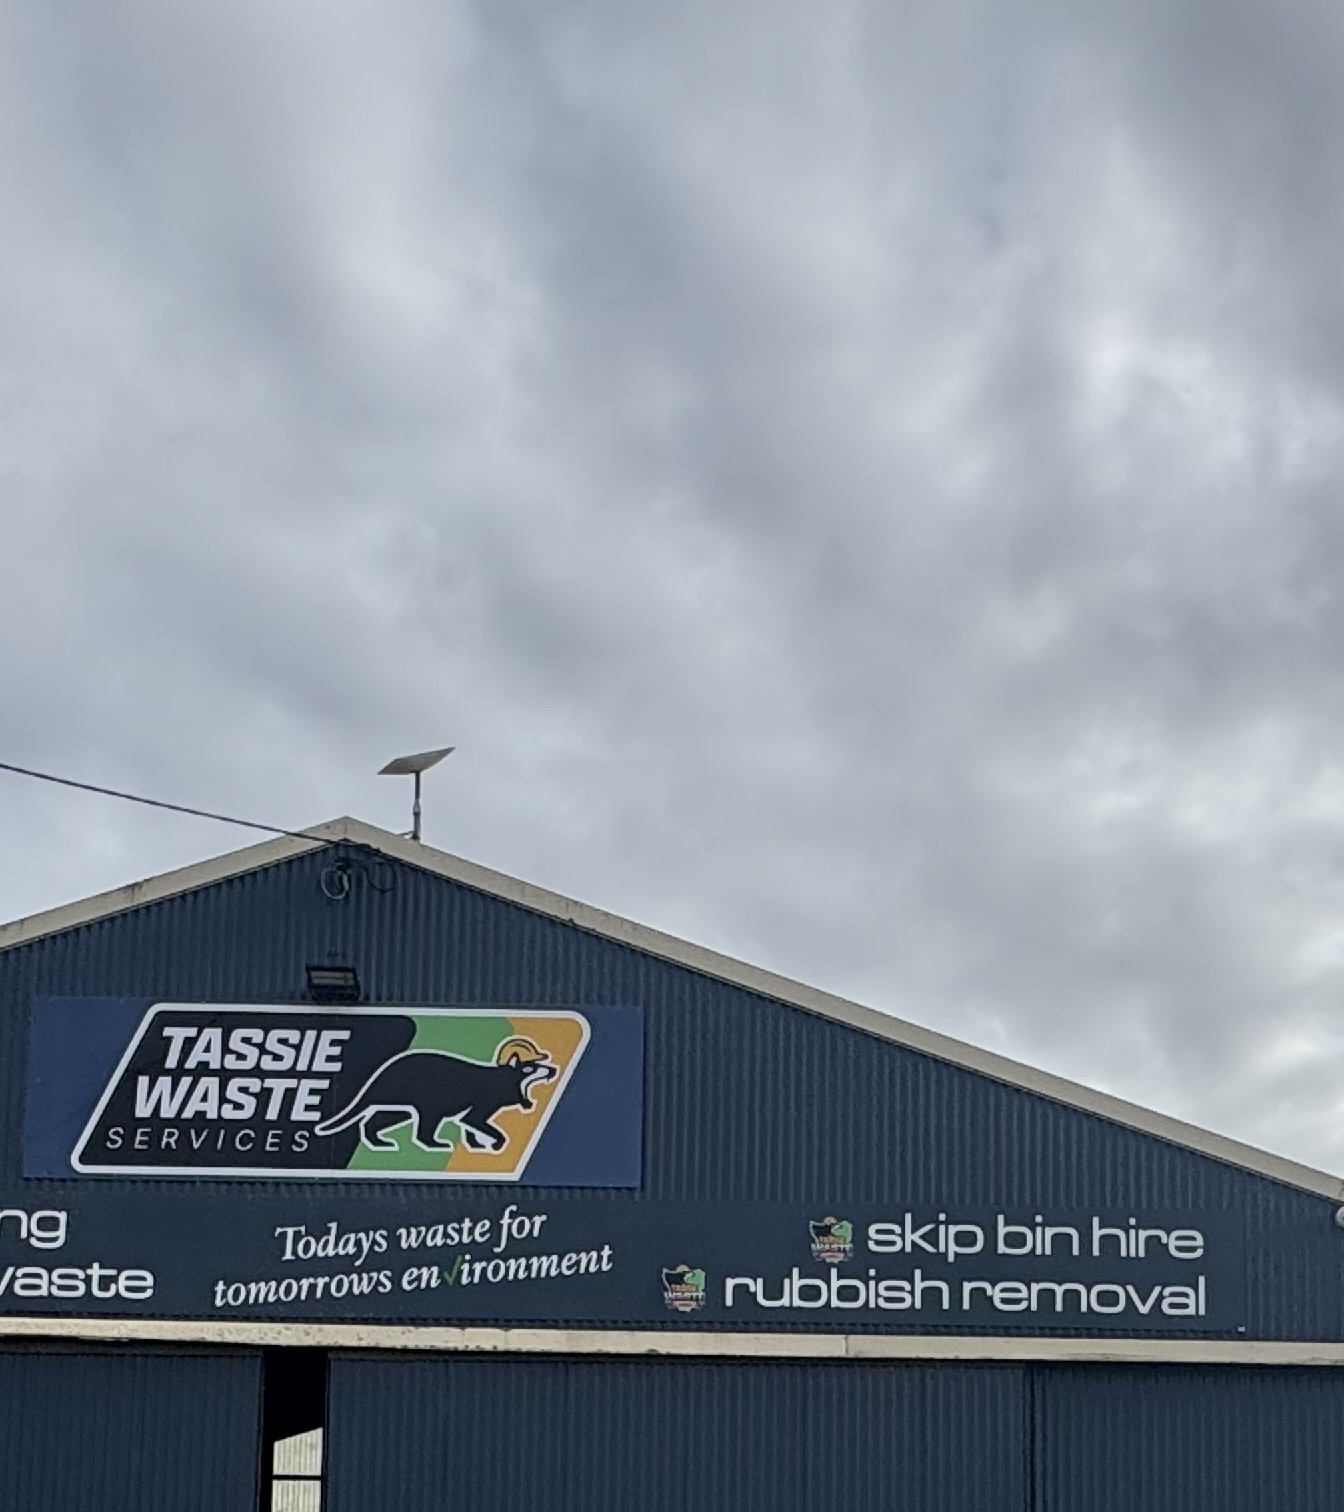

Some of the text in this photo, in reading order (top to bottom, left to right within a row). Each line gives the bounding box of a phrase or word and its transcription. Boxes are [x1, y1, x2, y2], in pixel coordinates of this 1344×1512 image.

[163, 1027, 350, 1071] TASSIE
[135, 1076, 323, 1121] WASTE
[107, 1128, 309, 1151] SERVICES
[275, 1205, 547, 1264] Todays waste for
[868, 1213, 983, 1262] skip
[998, 1215, 1079, 1255] bin
[1093, 1217, 1203, 1259] hire
[215, 1271, 391, 1307] tomorrows
[726, 1268, 949, 1309] rubbish
[963, 1276, 1205, 1315] removal
